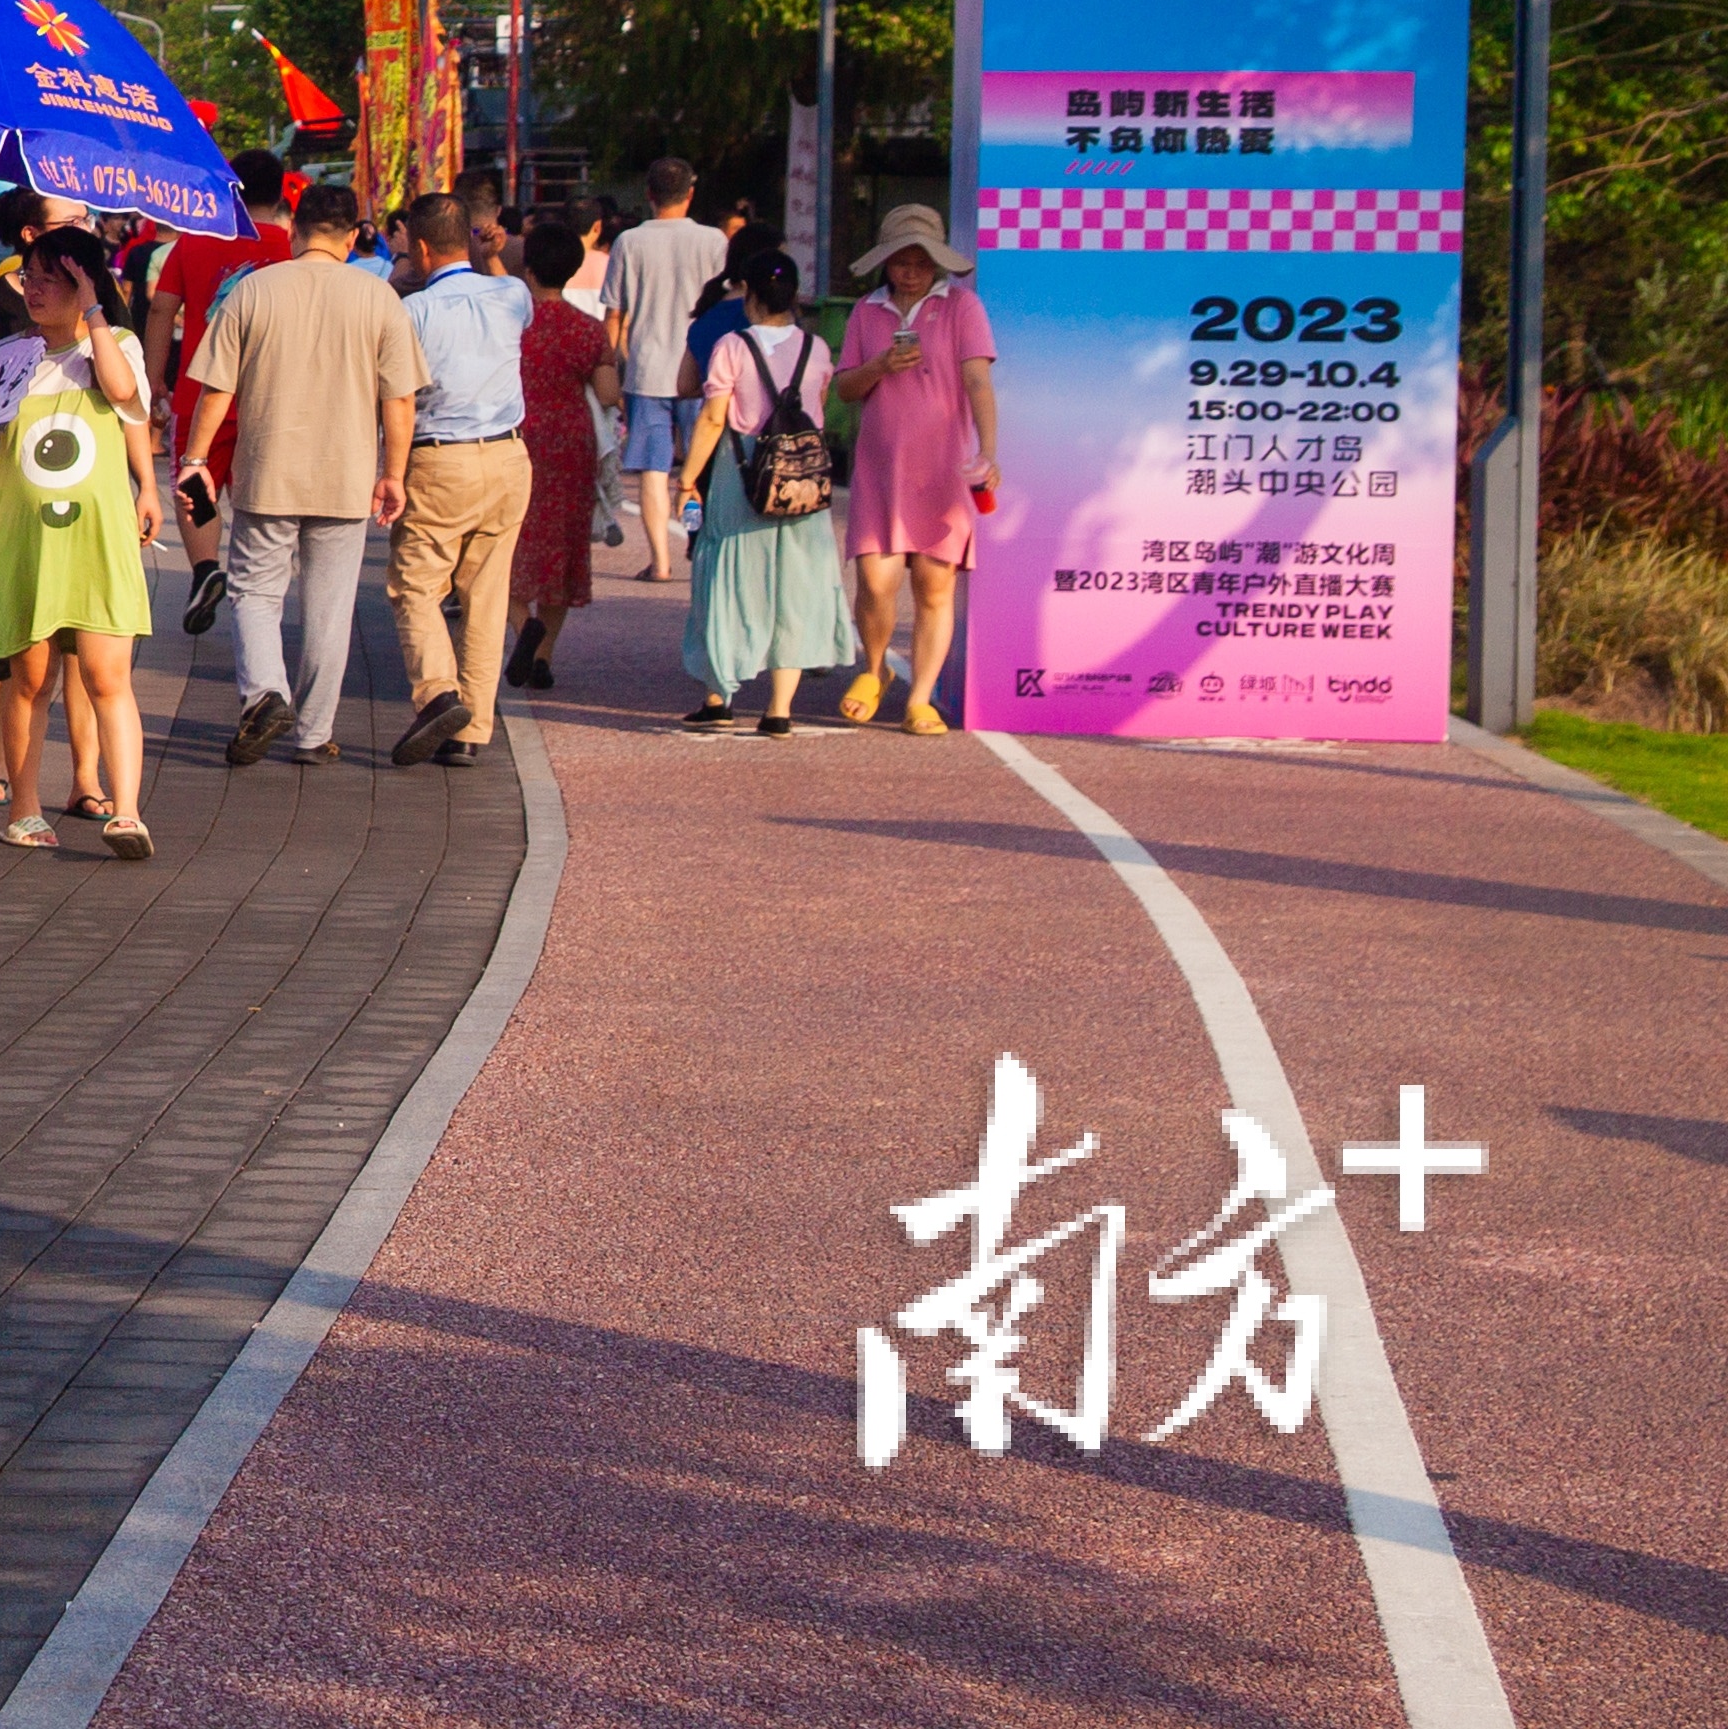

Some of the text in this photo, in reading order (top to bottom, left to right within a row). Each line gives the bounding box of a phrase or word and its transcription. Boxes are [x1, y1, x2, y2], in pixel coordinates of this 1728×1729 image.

[1066, 88, 1276, 120] 岛屿新生活
[1066, 126, 1276, 155] 不负你热爱
[1189, 295, 1404, 344] 2023
[1188, 359, 1401, 389] 9.29-10.4
[1187, 399, 1401, 423] 15:00-22:00
[1186, 434, 1363, 463] 江门人才岛
[1185, 468, 1399, 498] 潮头中央公园
[1053, 570, 1396, 599] 暨2023湾区青年户外直播大赛
[1216, 602, 1394, 620] TRENDY PLAY
[1196, 621, 1393, 640] CULTURE WEEK
